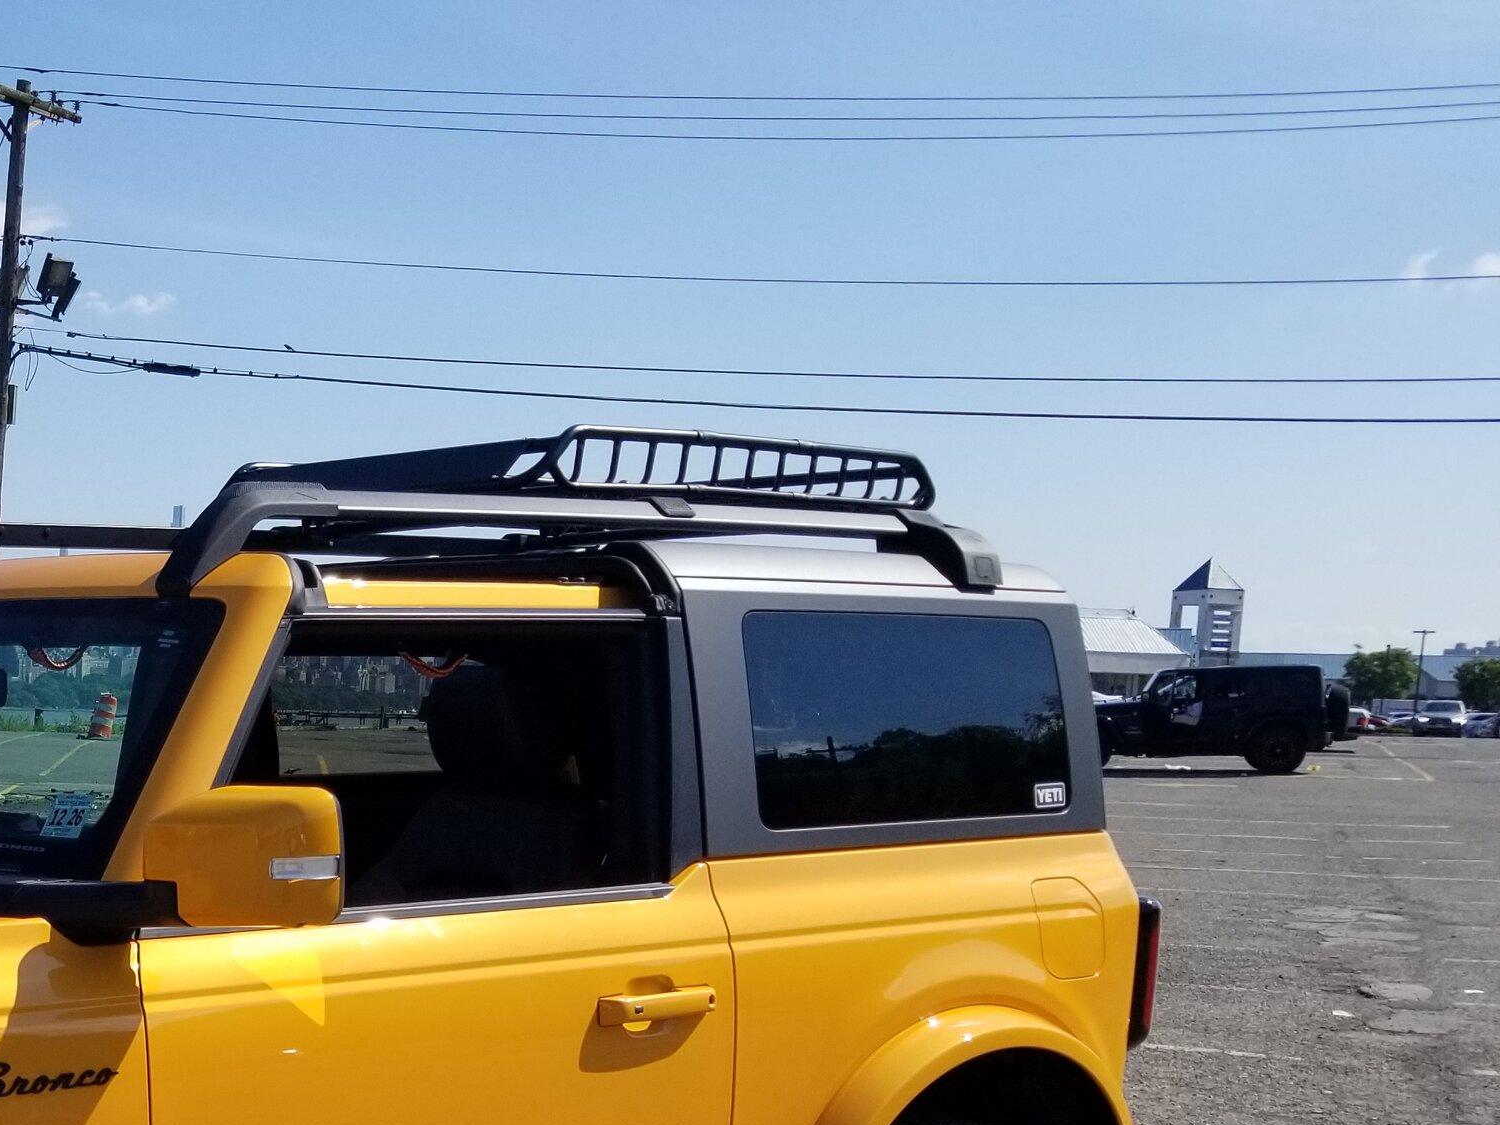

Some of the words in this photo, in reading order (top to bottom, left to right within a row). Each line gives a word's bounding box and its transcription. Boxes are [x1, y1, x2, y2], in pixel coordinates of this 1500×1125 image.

[1037, 788, 1063, 803] YETI
[49, 808, 68, 826] 12
[67, 808, 86, 827] 26
